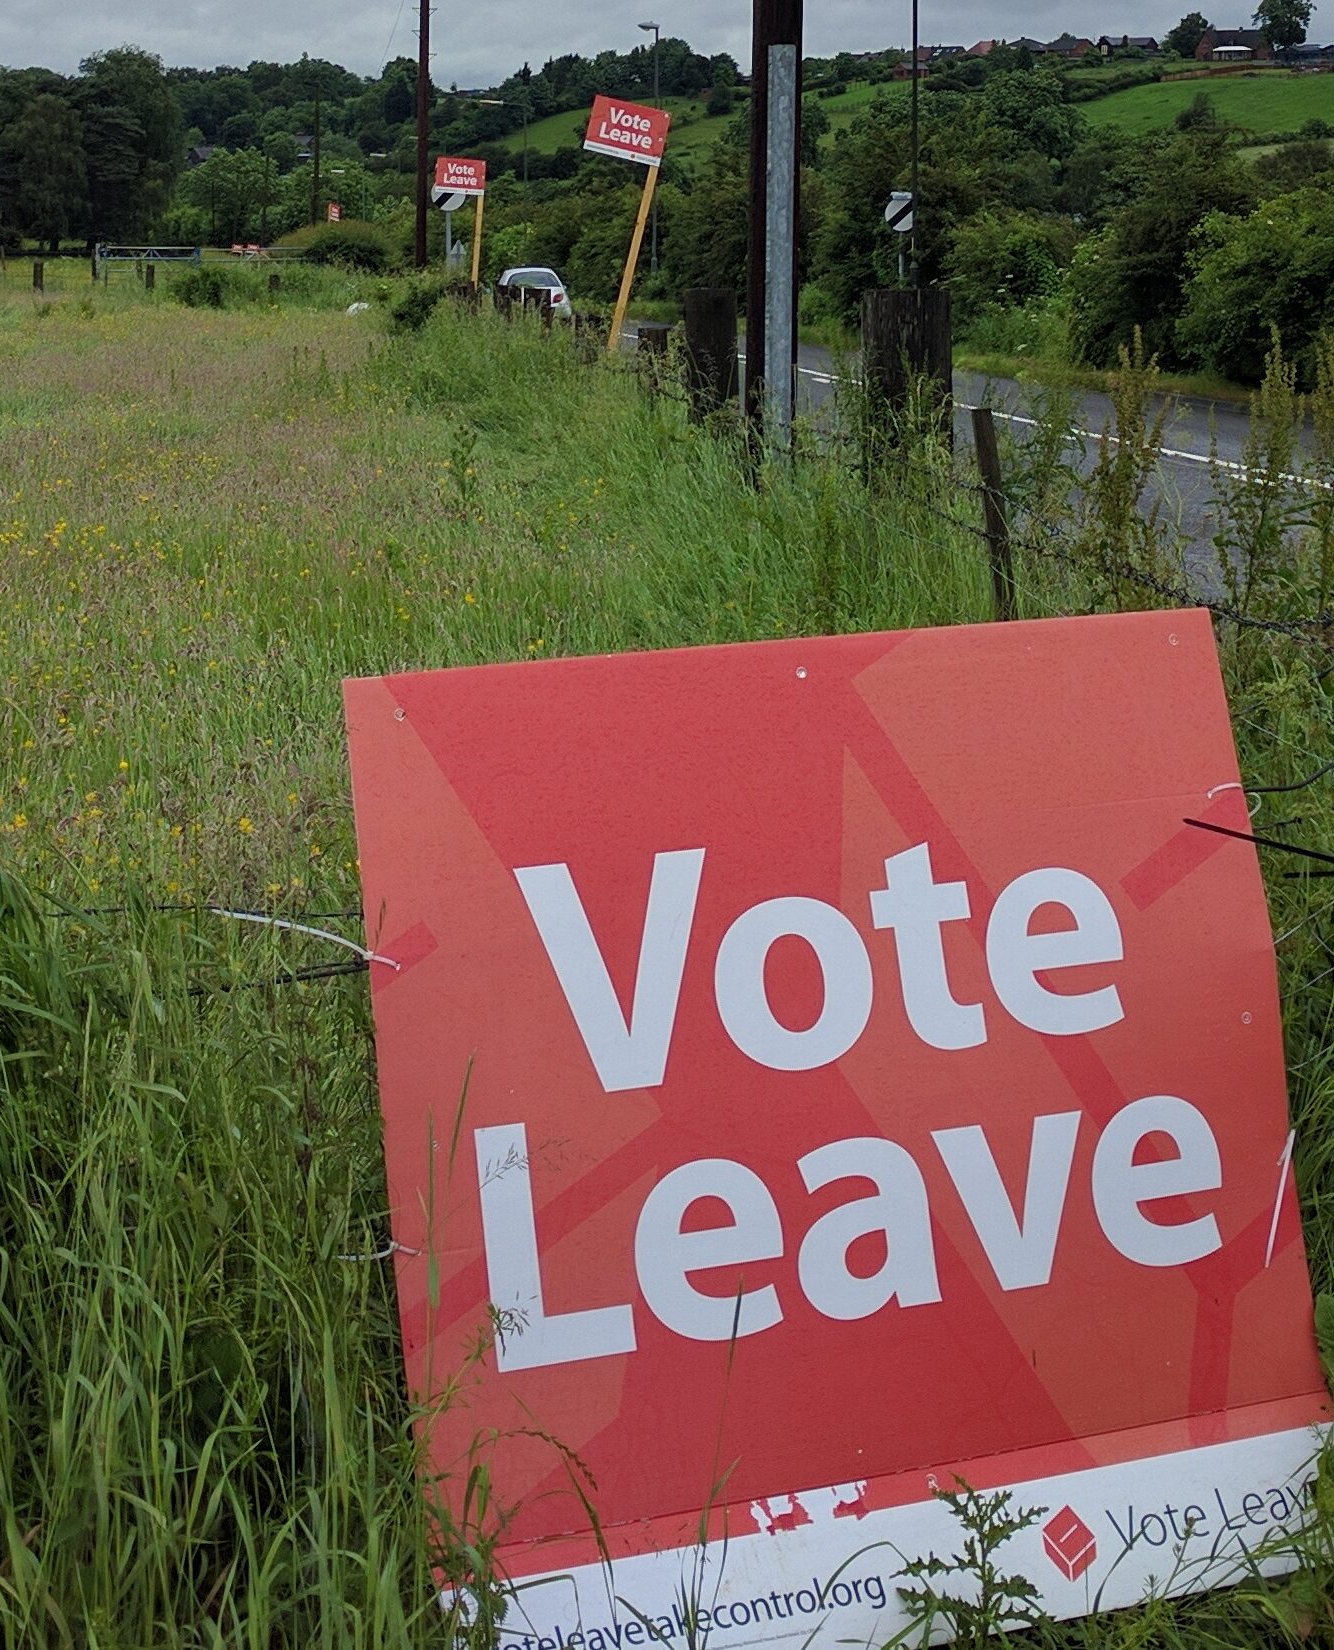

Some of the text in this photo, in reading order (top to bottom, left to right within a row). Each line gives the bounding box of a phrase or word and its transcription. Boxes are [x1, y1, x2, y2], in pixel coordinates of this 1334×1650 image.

[610, 107, 651, 132] Vote
[599, 122, 652, 149] Leave
[443, 173, 477, 186] Leave
[447, 163, 475, 175] Vote
[513, 842, 1126, 1093] Vote
[474, 1095, 1223, 1373] Leave
[1105, 1480, 1309, 1551] Vote Leav
